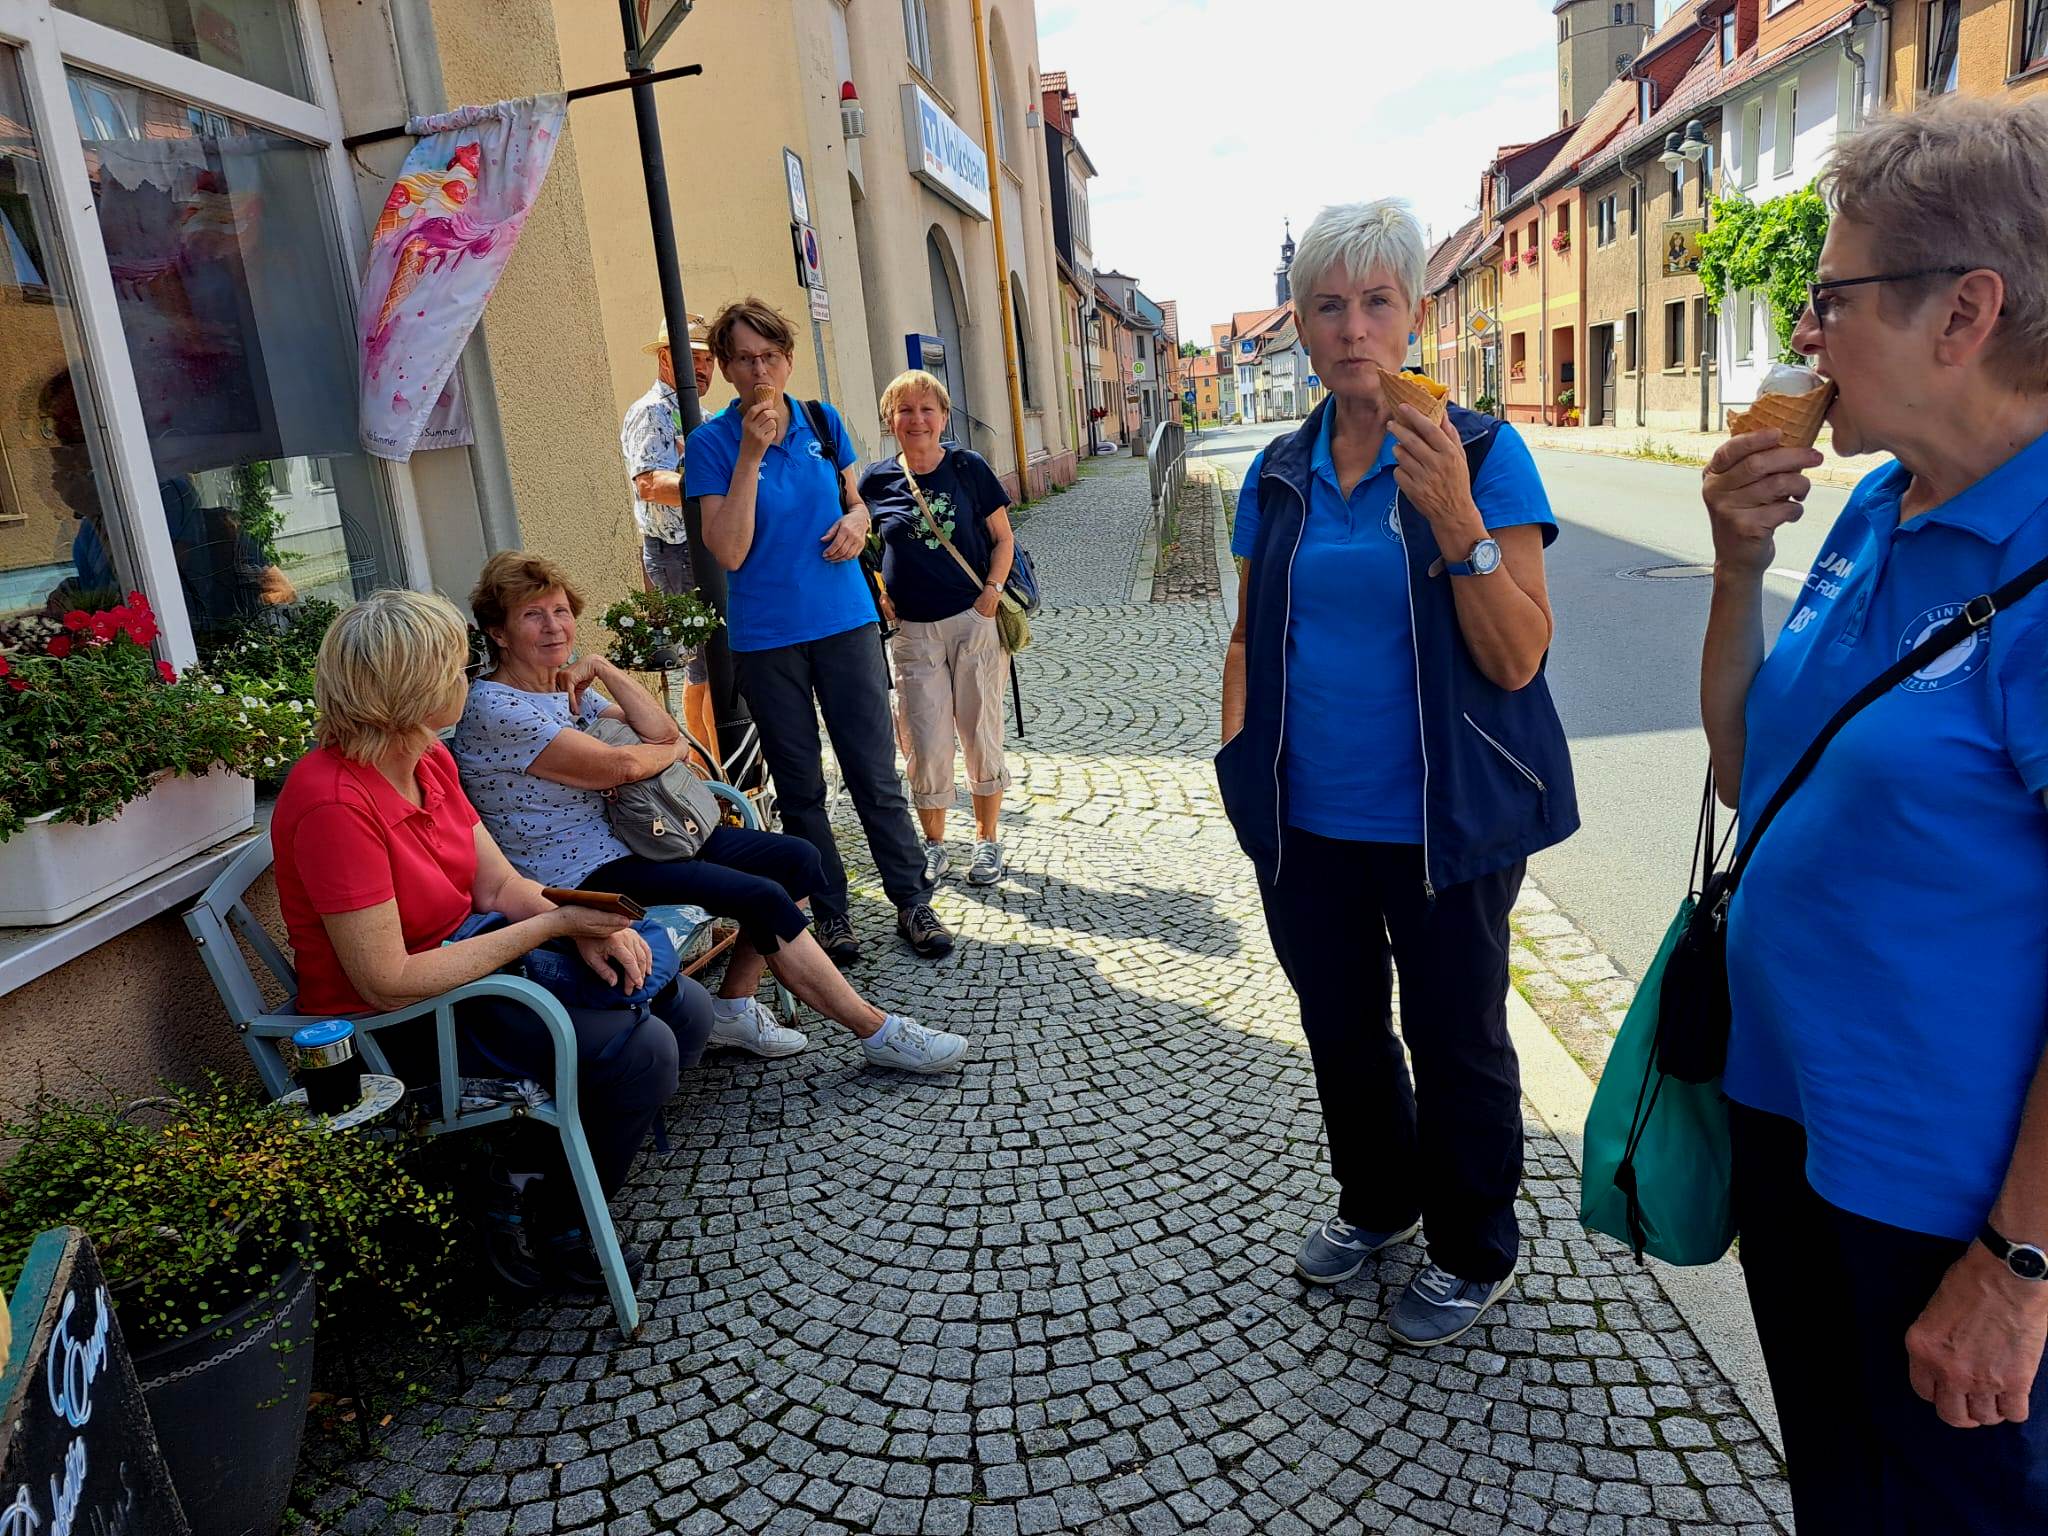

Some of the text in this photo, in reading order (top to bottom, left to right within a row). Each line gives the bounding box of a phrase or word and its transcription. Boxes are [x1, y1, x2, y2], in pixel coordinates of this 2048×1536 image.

[941, 121, 987, 194] Volksbank
[424, 427, 457, 437] Summer
[1818, 552, 1857, 578] JAK
